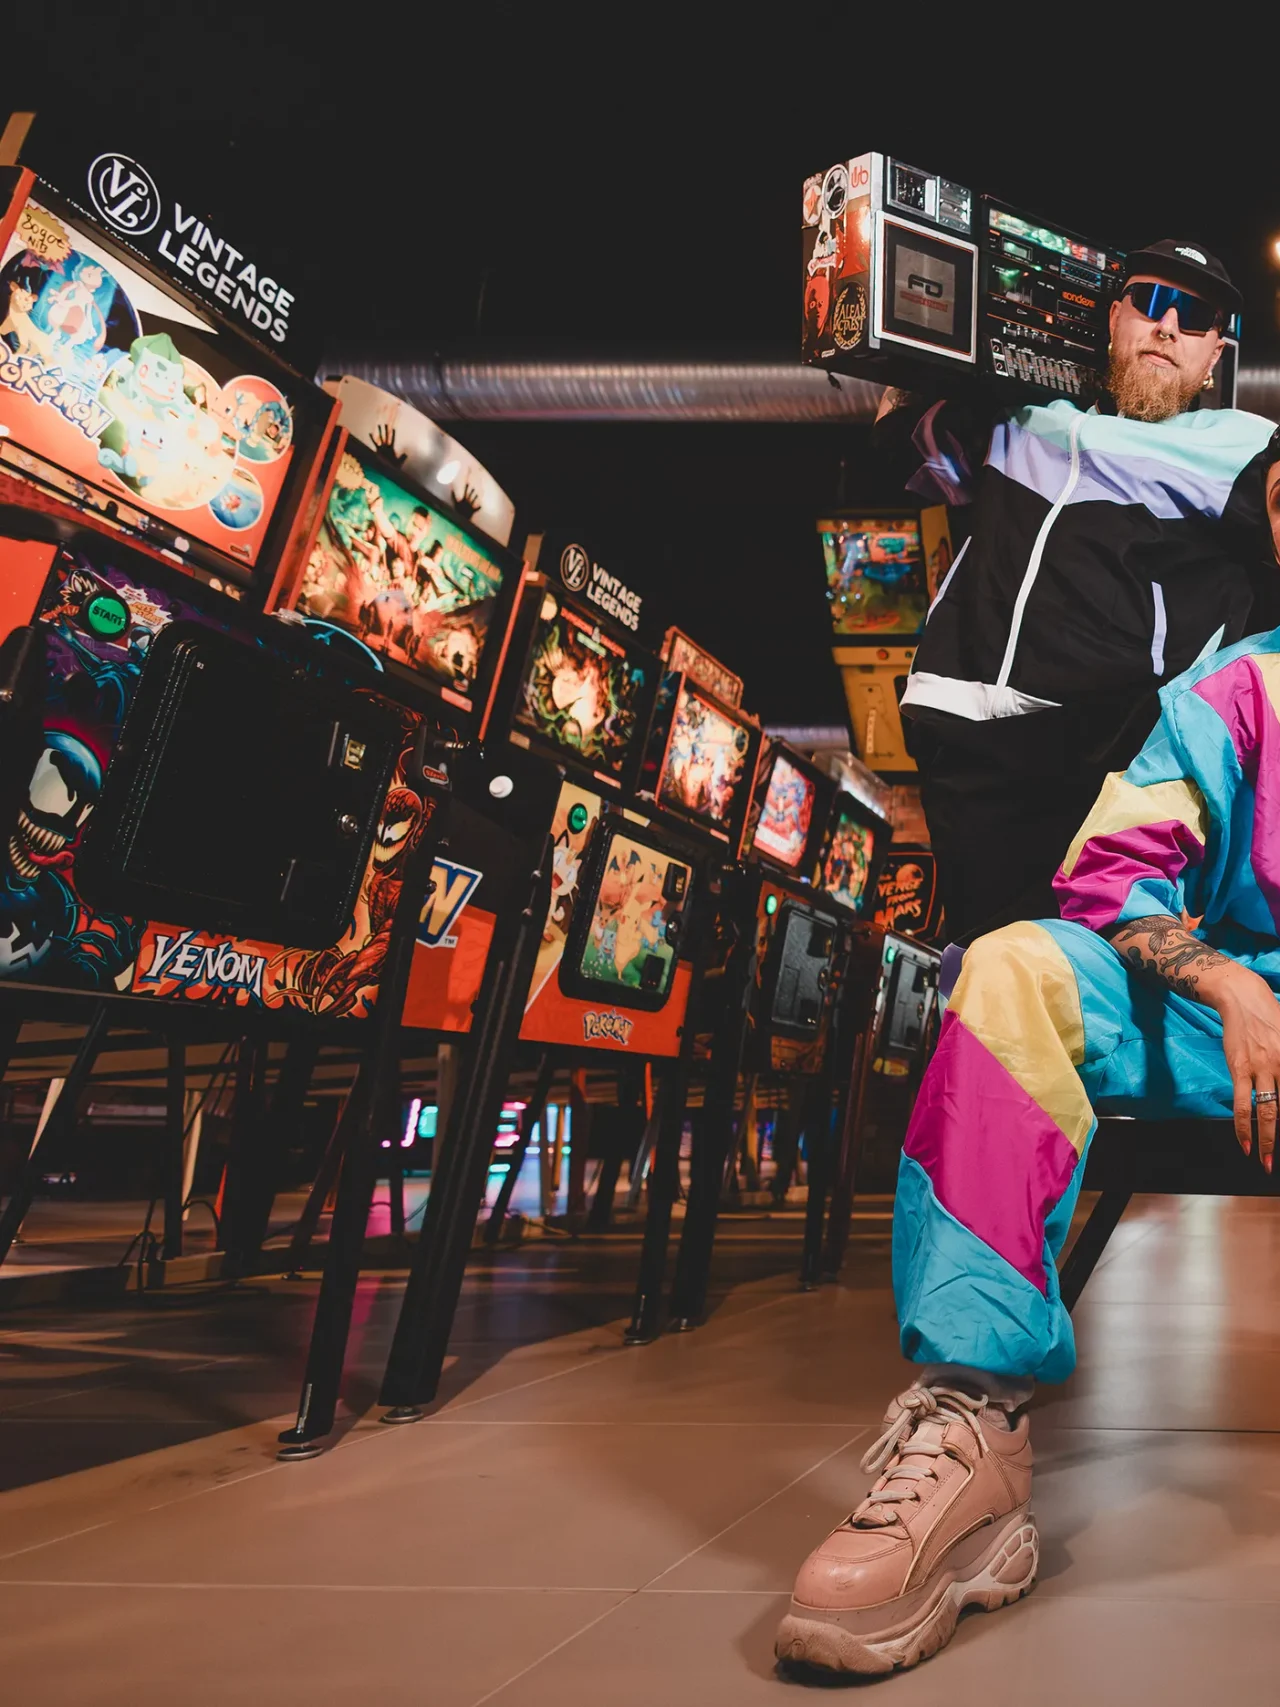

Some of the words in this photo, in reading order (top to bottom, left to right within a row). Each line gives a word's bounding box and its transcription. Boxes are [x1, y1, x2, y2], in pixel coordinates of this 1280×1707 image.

[157, 229, 289, 343] LEGENDS
[174, 202, 296, 318] VINTAGE
[92, 605, 124, 626] START
[586, 580, 640, 632] LEGENDS
[592, 561, 643, 614] VINTAGE
[145, 930, 266, 999] VENOM
